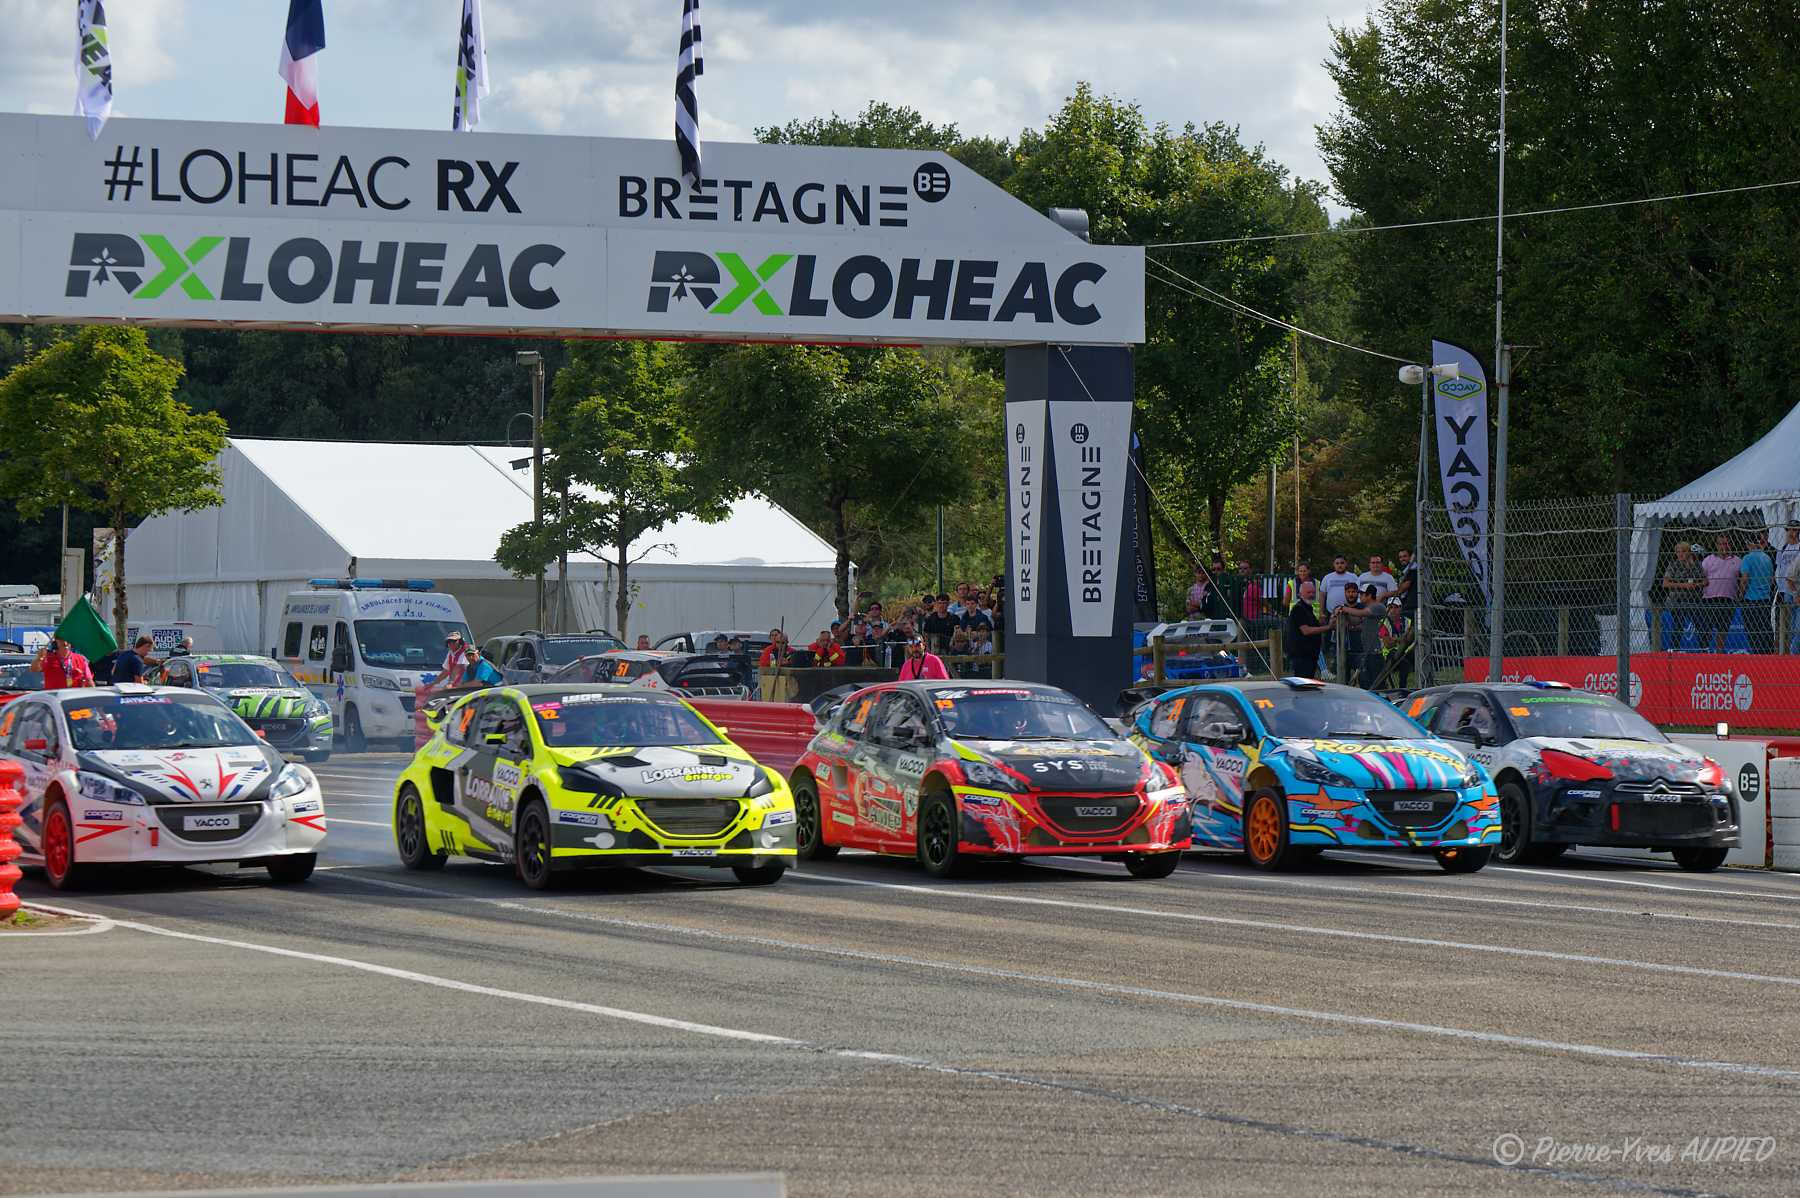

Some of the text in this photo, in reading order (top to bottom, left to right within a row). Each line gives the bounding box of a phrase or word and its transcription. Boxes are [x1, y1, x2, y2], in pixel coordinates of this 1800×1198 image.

[104, 144, 523, 214] #LOHEAC RX
[618, 174, 909, 228] BRETAGNE
[1019, 446, 1032, 602] BRETAGNE
[1081, 446, 1103, 604] BRETAGNE
[1584, 671, 1618, 691] oues
[1695, 669, 1734, 691] ouest
[1690, 689, 1733, 711] france
[641, 765, 717, 785] LORRAINE
[898, 757, 926, 776] YACCO
[1032, 759, 1084, 773] SYS
[1215, 757, 1244, 773] YACCO
[560, 811, 599, 820] COOPER
[1078, 806, 1114, 816] YACCO
[1397, 801, 1432, 811] YACCO
[193, 818, 230, 828] YACCO
